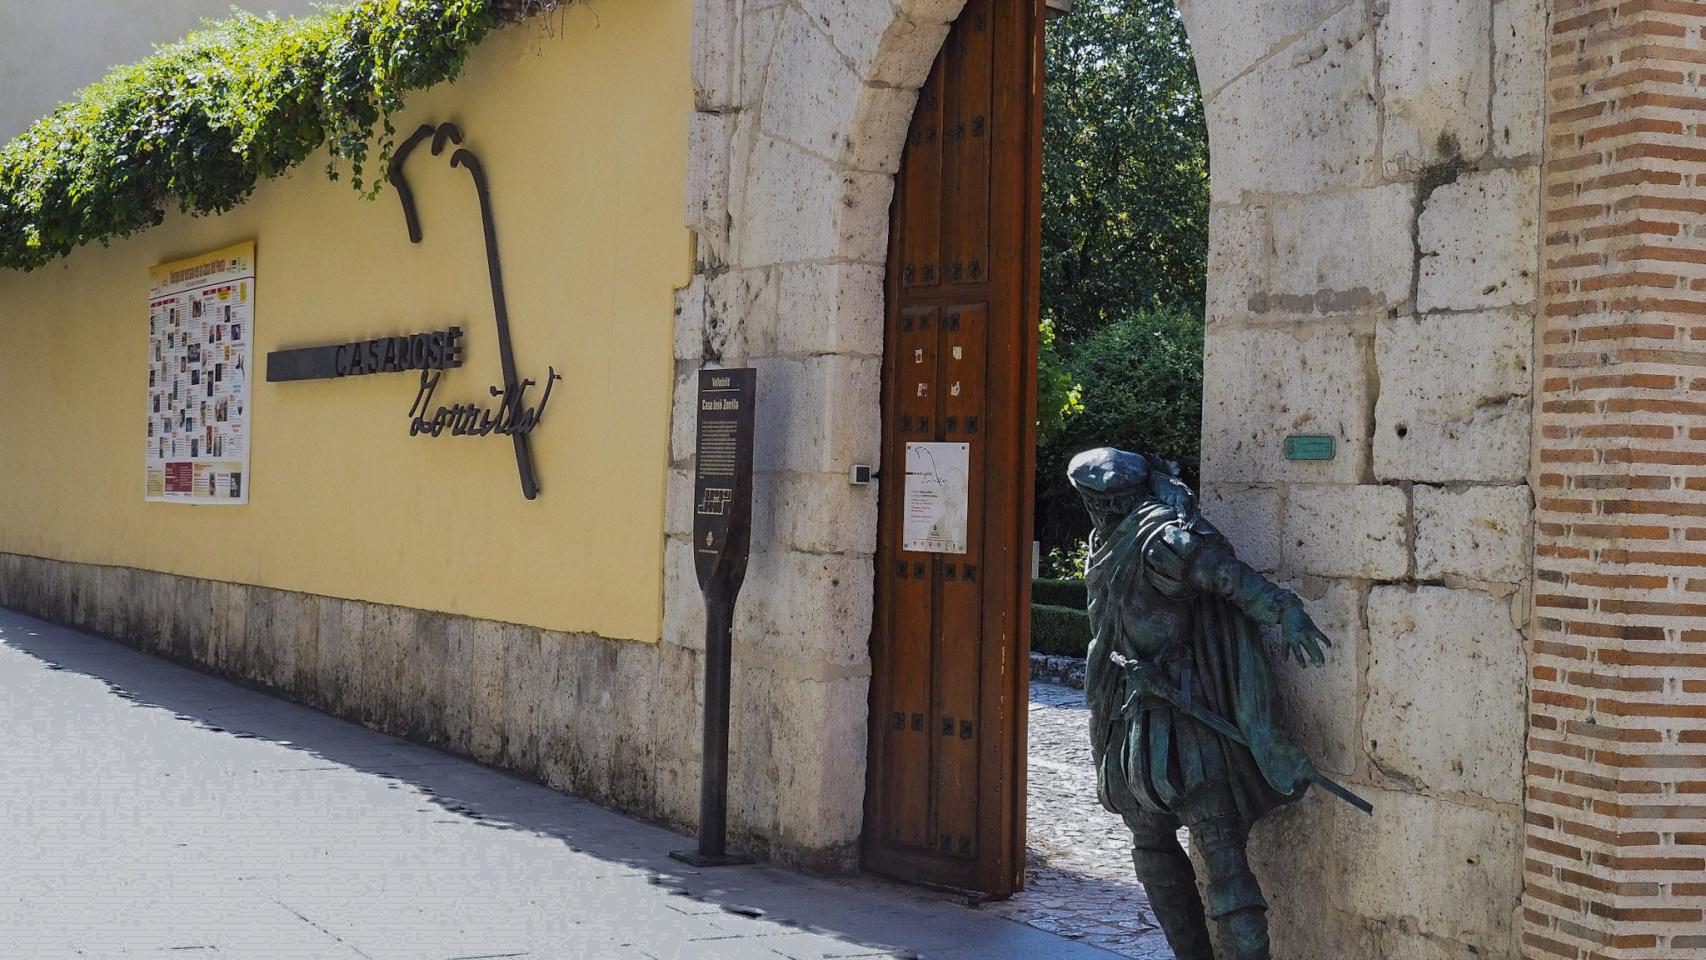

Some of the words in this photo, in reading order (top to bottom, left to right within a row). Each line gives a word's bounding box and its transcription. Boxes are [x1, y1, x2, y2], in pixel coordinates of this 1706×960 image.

[702, 399, 713, 411] Casa
[713, 398, 723, 411] José
[723, 398, 739, 411] Zorrilla
